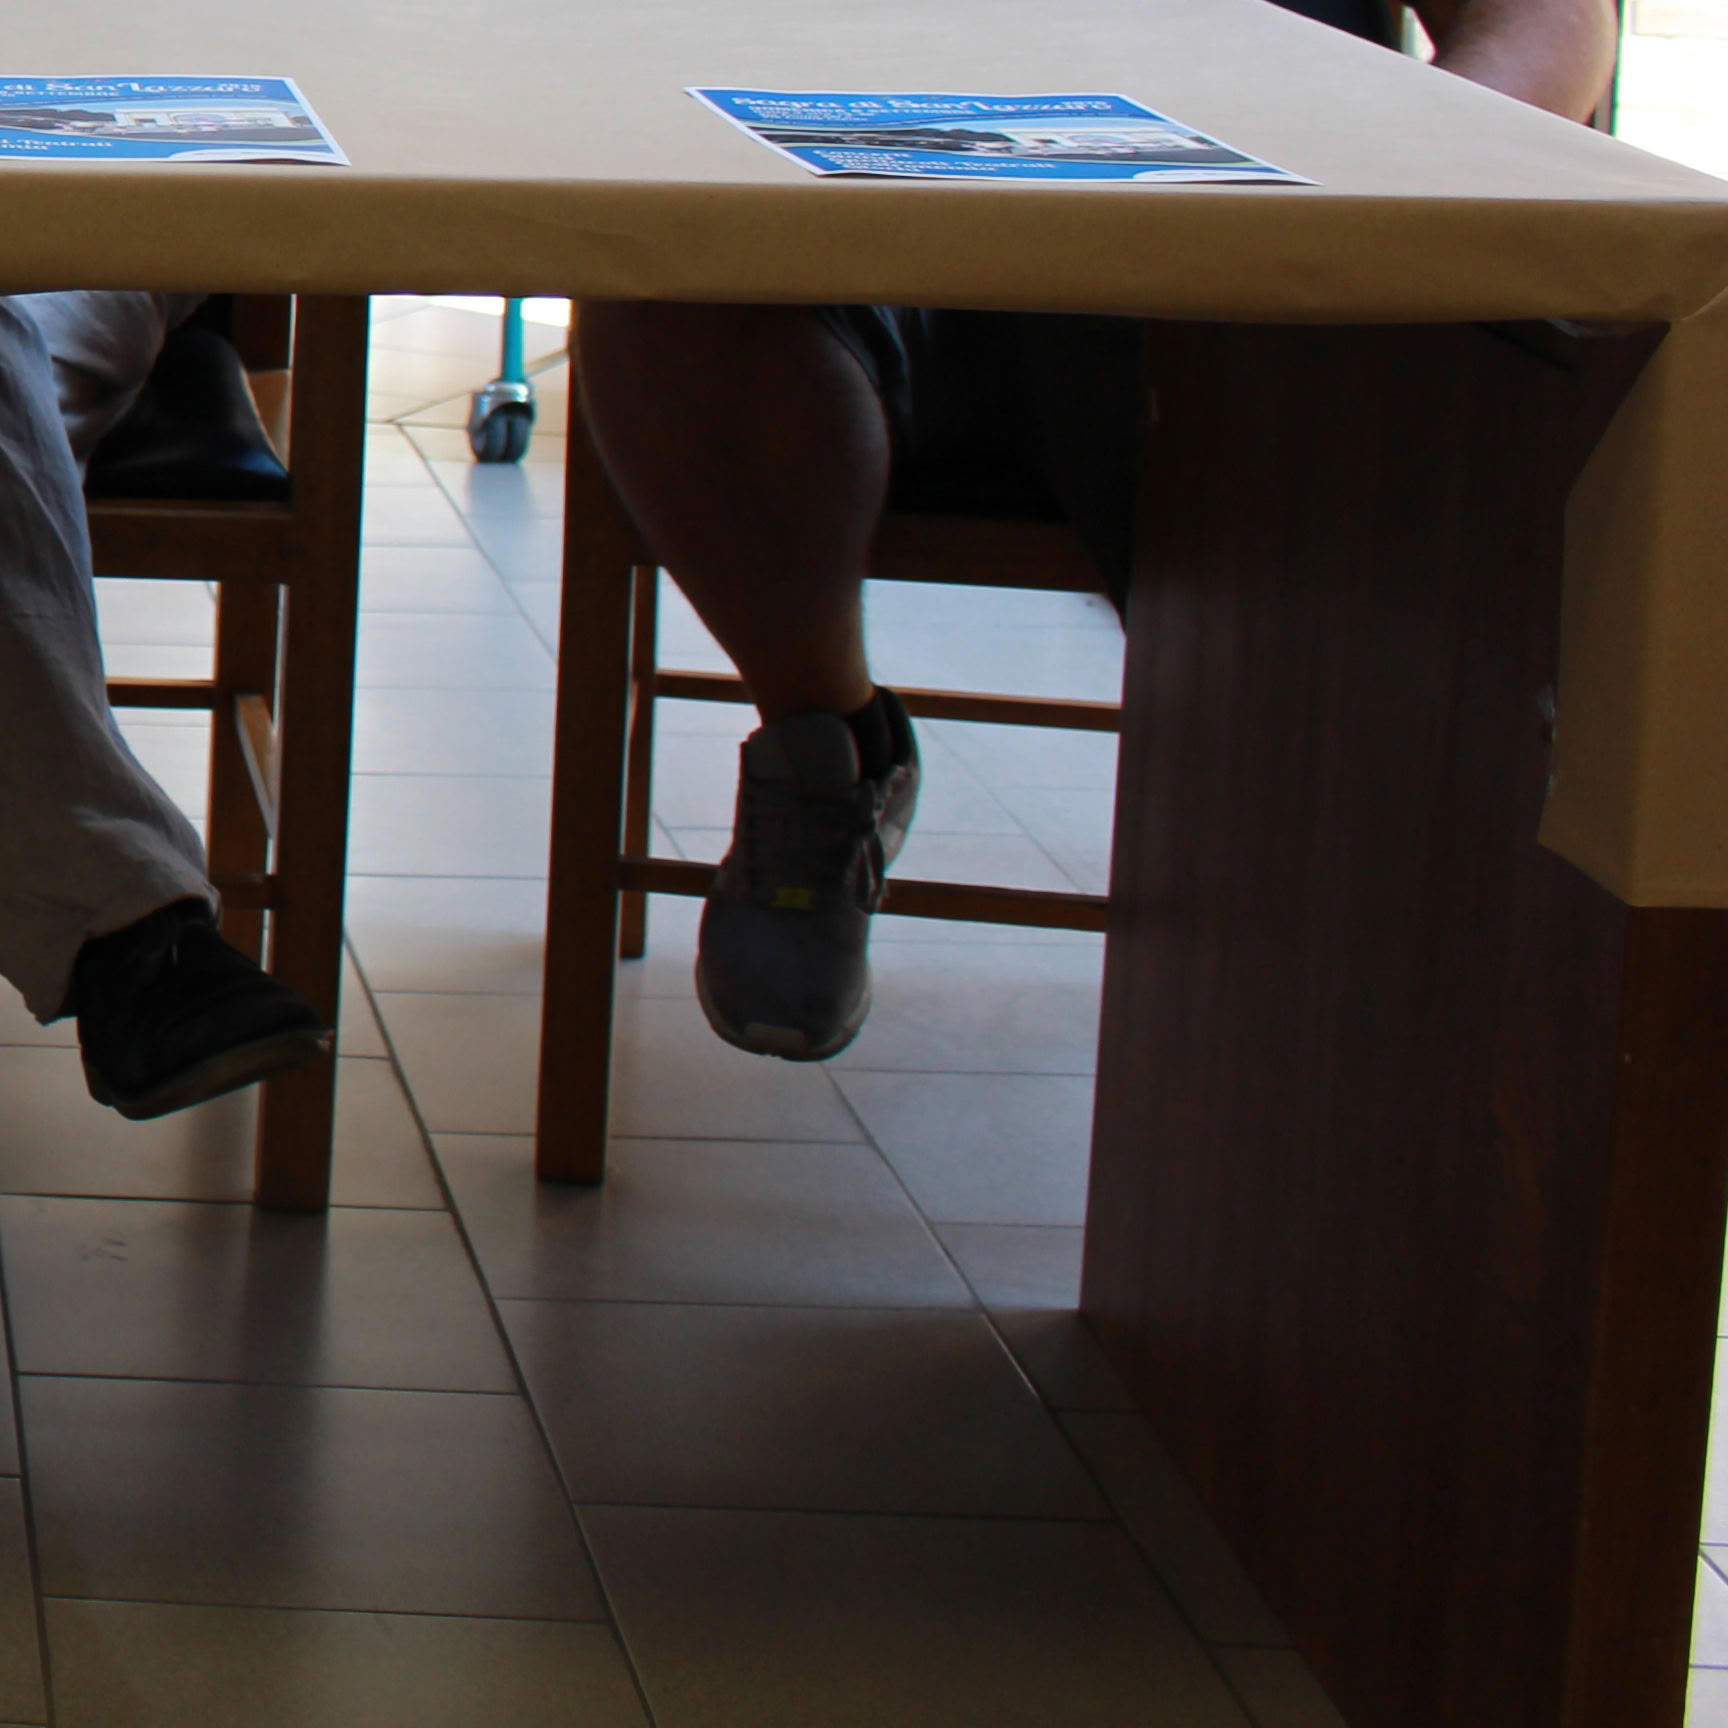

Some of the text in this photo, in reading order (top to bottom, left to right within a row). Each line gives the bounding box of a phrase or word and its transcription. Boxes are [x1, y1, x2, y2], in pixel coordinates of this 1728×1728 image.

[3, 83, 34, 91] di
[45, 82, 116, 92] San
[731, 97, 841, 108] Sagra
[849, 100, 883, 108] di
[888, 99, 964, 109] San
